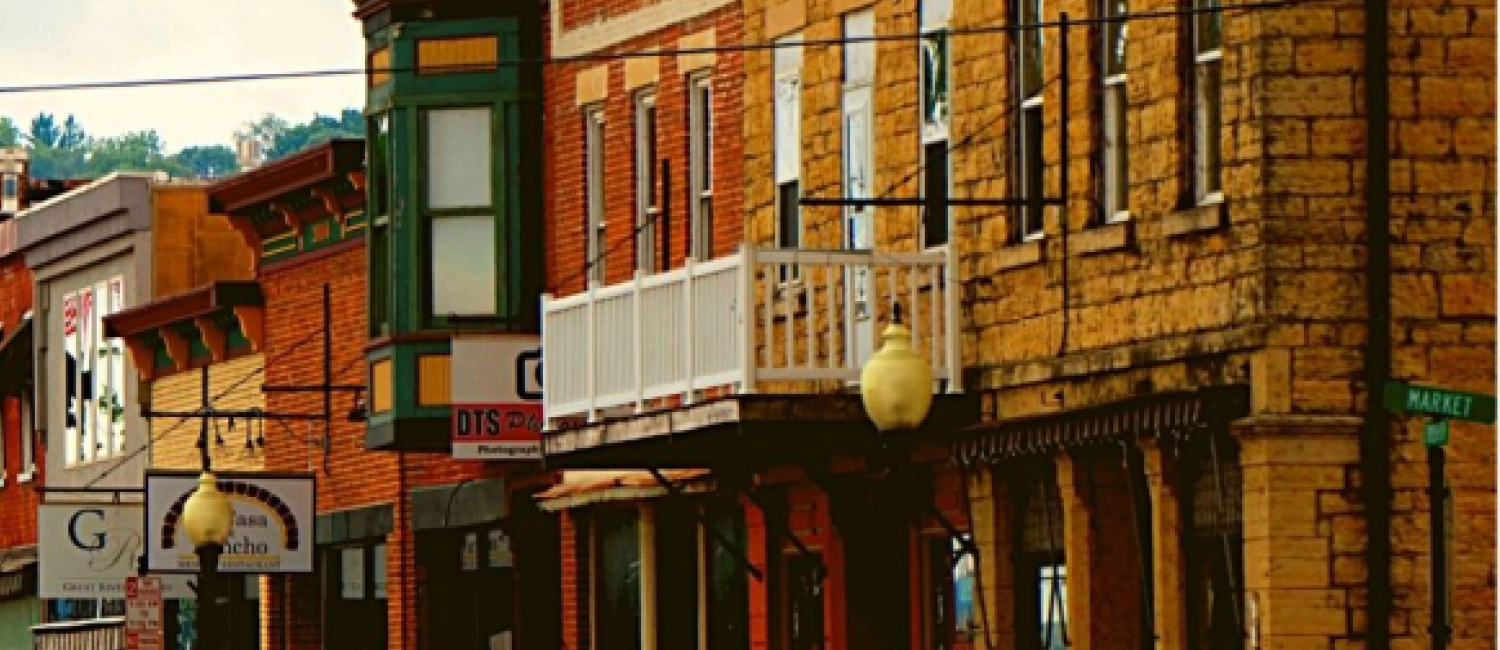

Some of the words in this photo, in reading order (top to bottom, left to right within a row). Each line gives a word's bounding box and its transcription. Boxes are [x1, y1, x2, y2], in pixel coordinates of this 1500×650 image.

[1406, 388, 1473, 417] MARKET
[457, 409, 500, 435] DTS
[478, 445, 541, 456] Photograph
[233, 510, 268, 528] asa
[68, 509, 107, 550] G
[224, 536, 268, 554] ncho
[99, 581, 126, 591] RIVE
